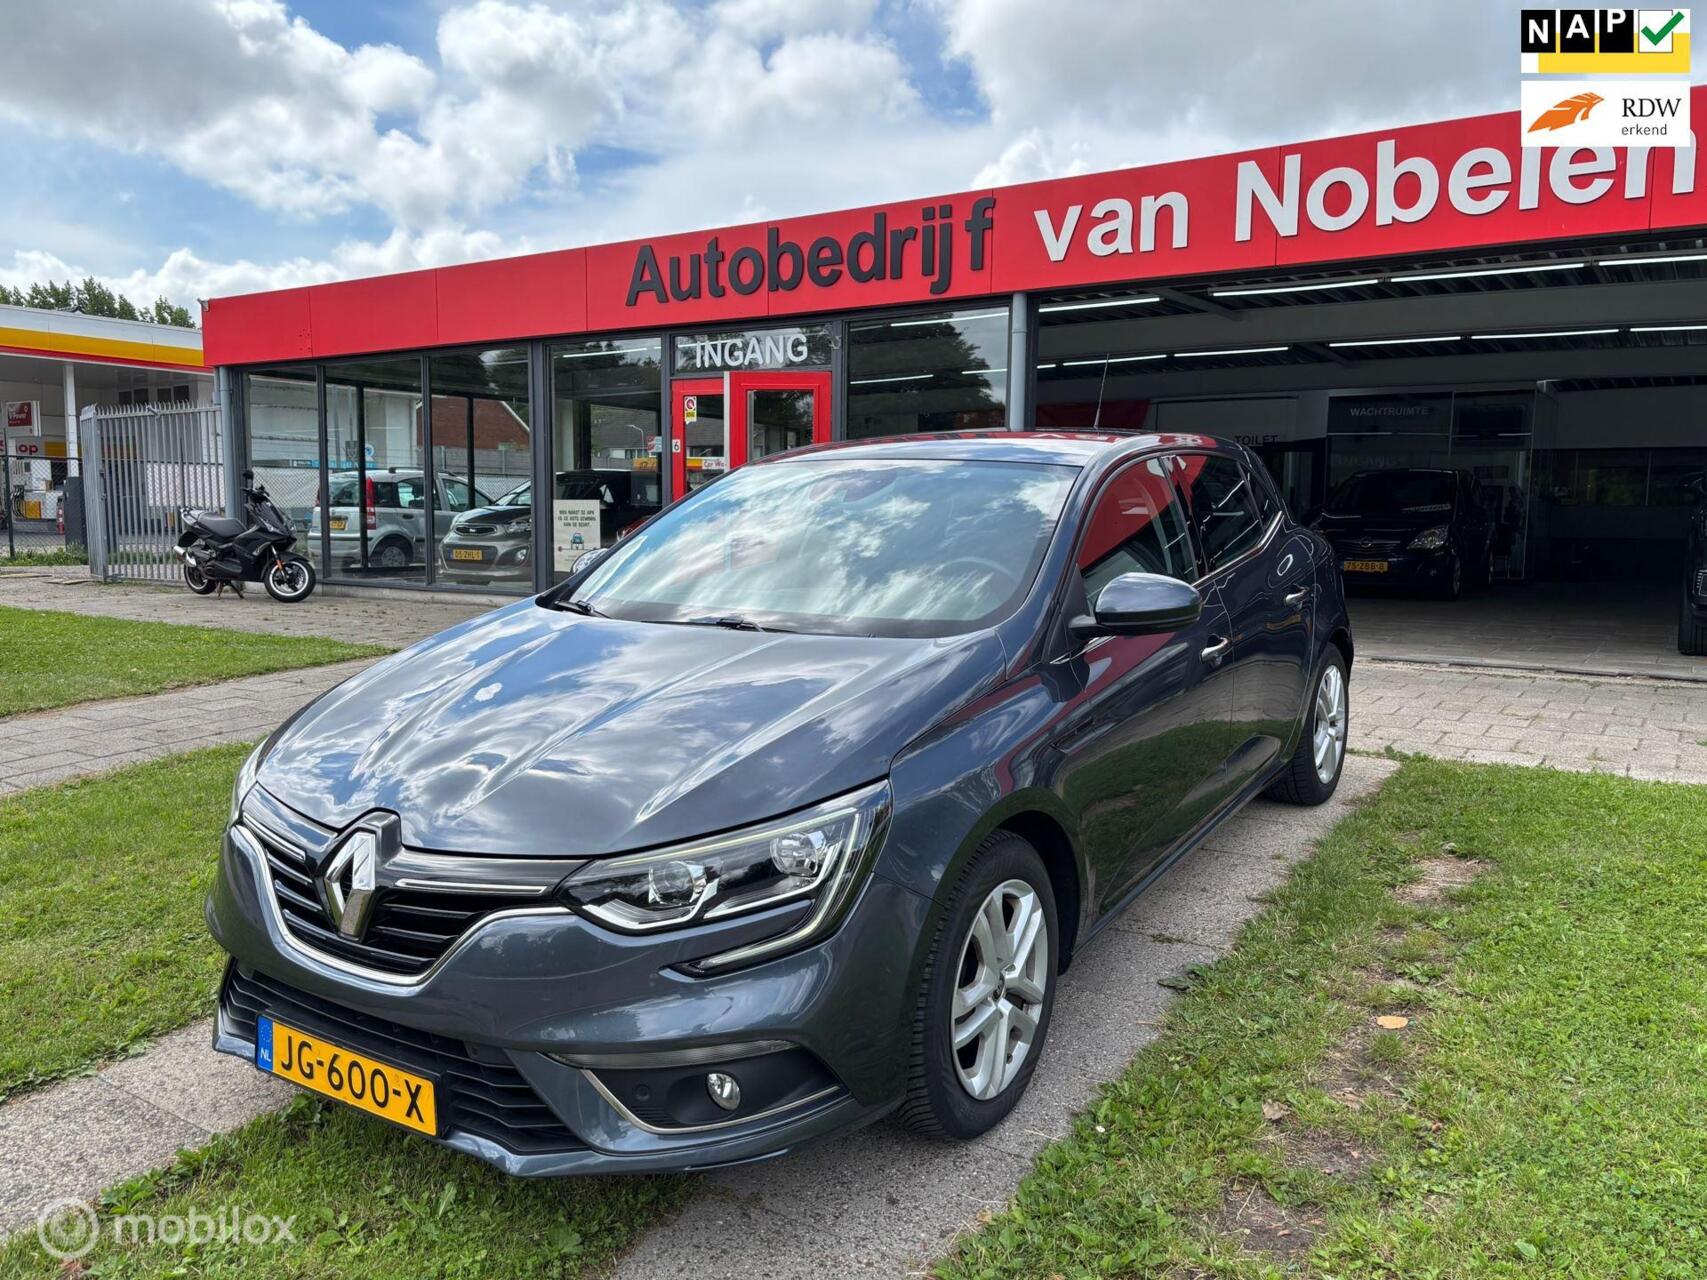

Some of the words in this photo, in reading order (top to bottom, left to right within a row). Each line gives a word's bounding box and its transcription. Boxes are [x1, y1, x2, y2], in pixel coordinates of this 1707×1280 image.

[626, 197, 997, 307] Autobedrijf
[1033, 190, 1190, 263] van
[1235, 128, 1698, 242] Nobelen
[696, 333, 808, 369] INGANG
[1350, 406, 1430, 417] WACHTRUIMTE
[673, 441, 681, 452] 6
[1234, 434, 1279, 446] TOILET
[260, 1047, 272, 1063] NL
[281, 1035, 424, 1124] JG-600-X
